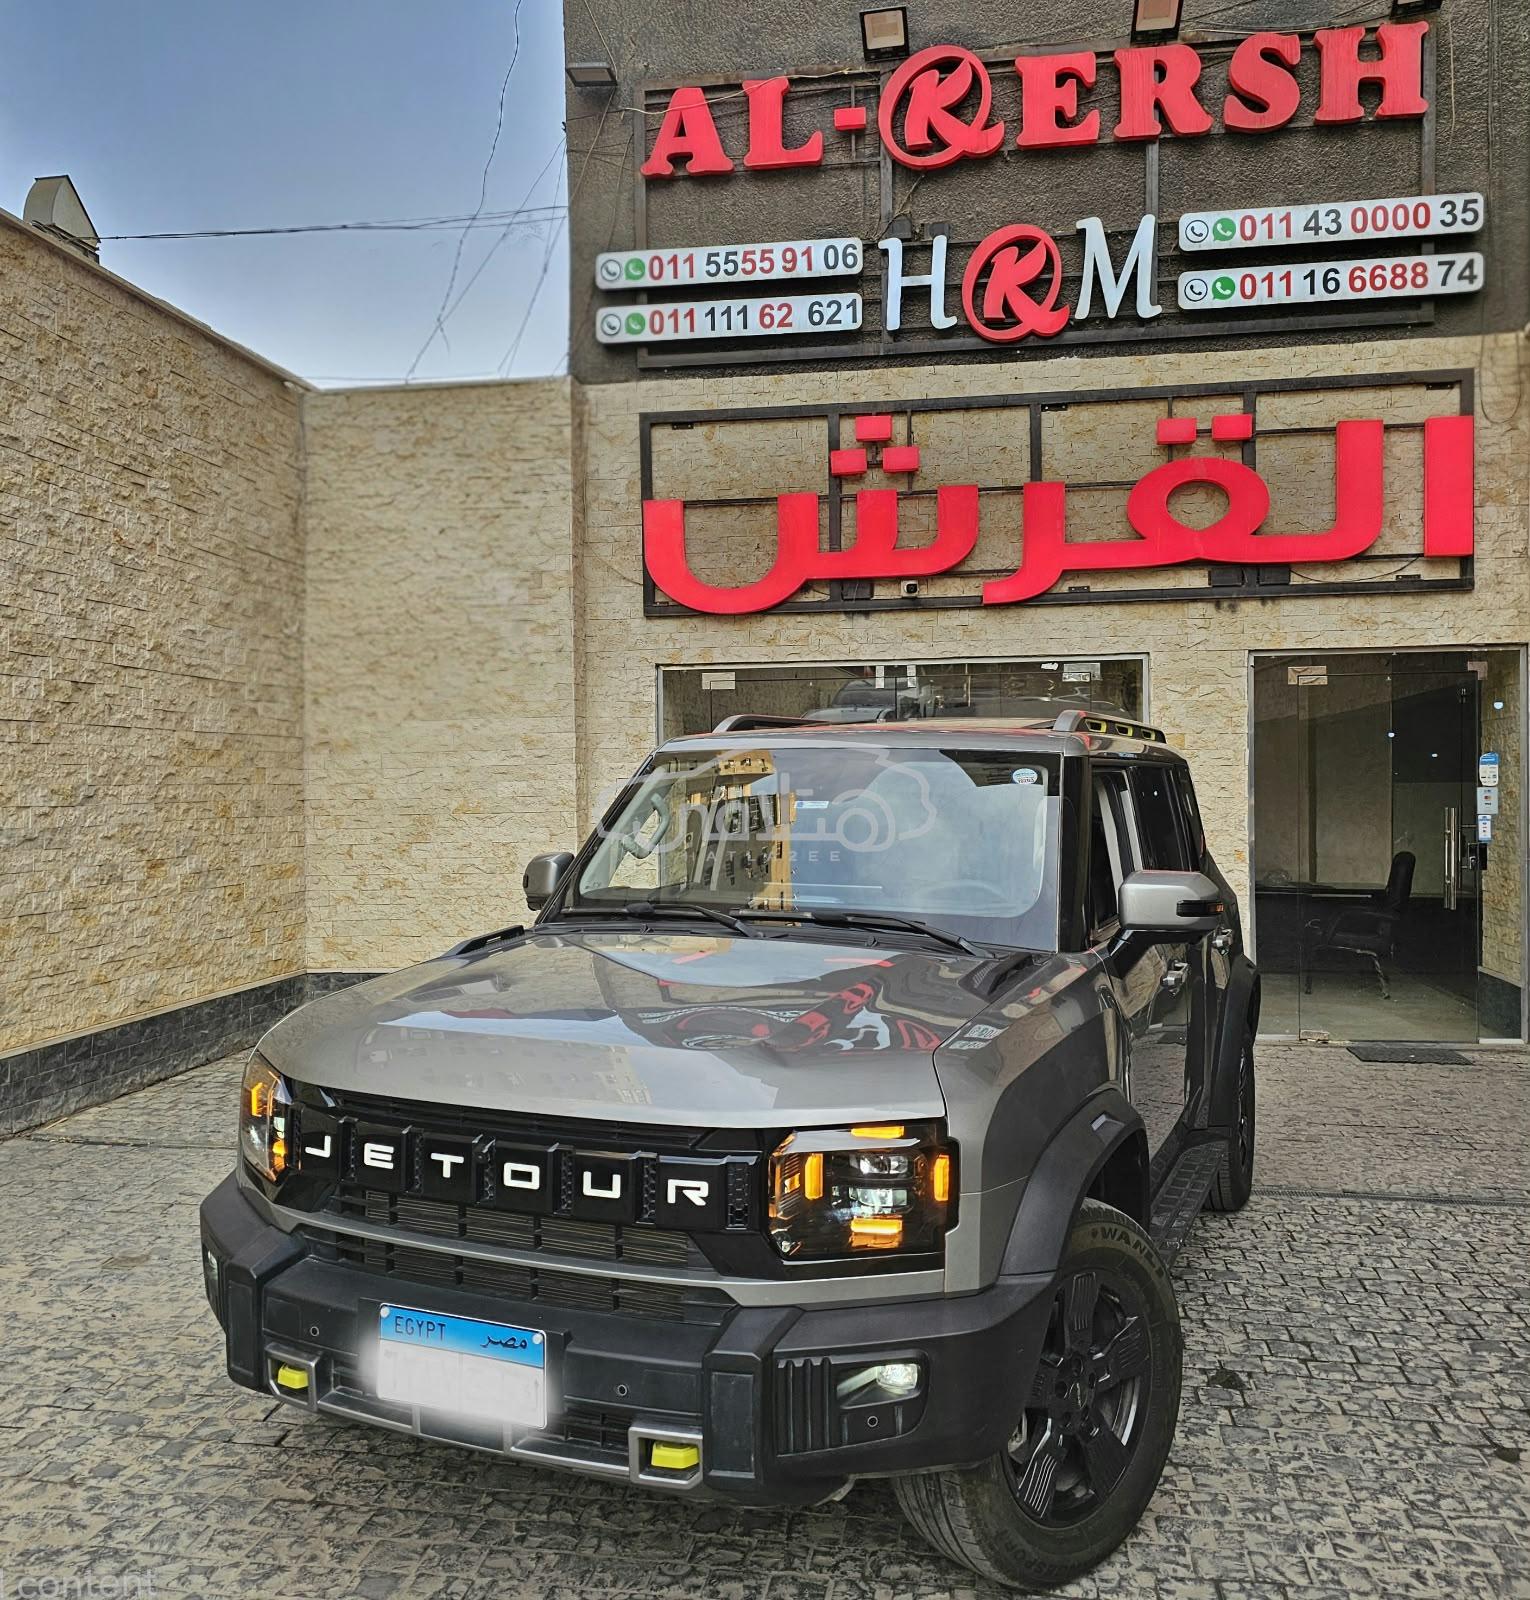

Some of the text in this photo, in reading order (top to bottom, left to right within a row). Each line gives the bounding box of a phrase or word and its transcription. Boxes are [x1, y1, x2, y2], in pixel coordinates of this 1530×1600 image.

[1239, 199, 1480, 241] 011 43 0000 35
[649, 253, 695, 281] 011
[781, 246, 813, 272] 91
[823, 243, 858, 270] 06
[1239, 258, 1478, 299] 011 16 6688 74
[649, 299, 859, 336] 011 111 62 621
[643, 413, 1475, 615] القرش
[304, 1134, 709, 1206] JETOUR
[394, 1315, 447, 1341] EGYPT
[479, 1334, 528, 1351] مصر
